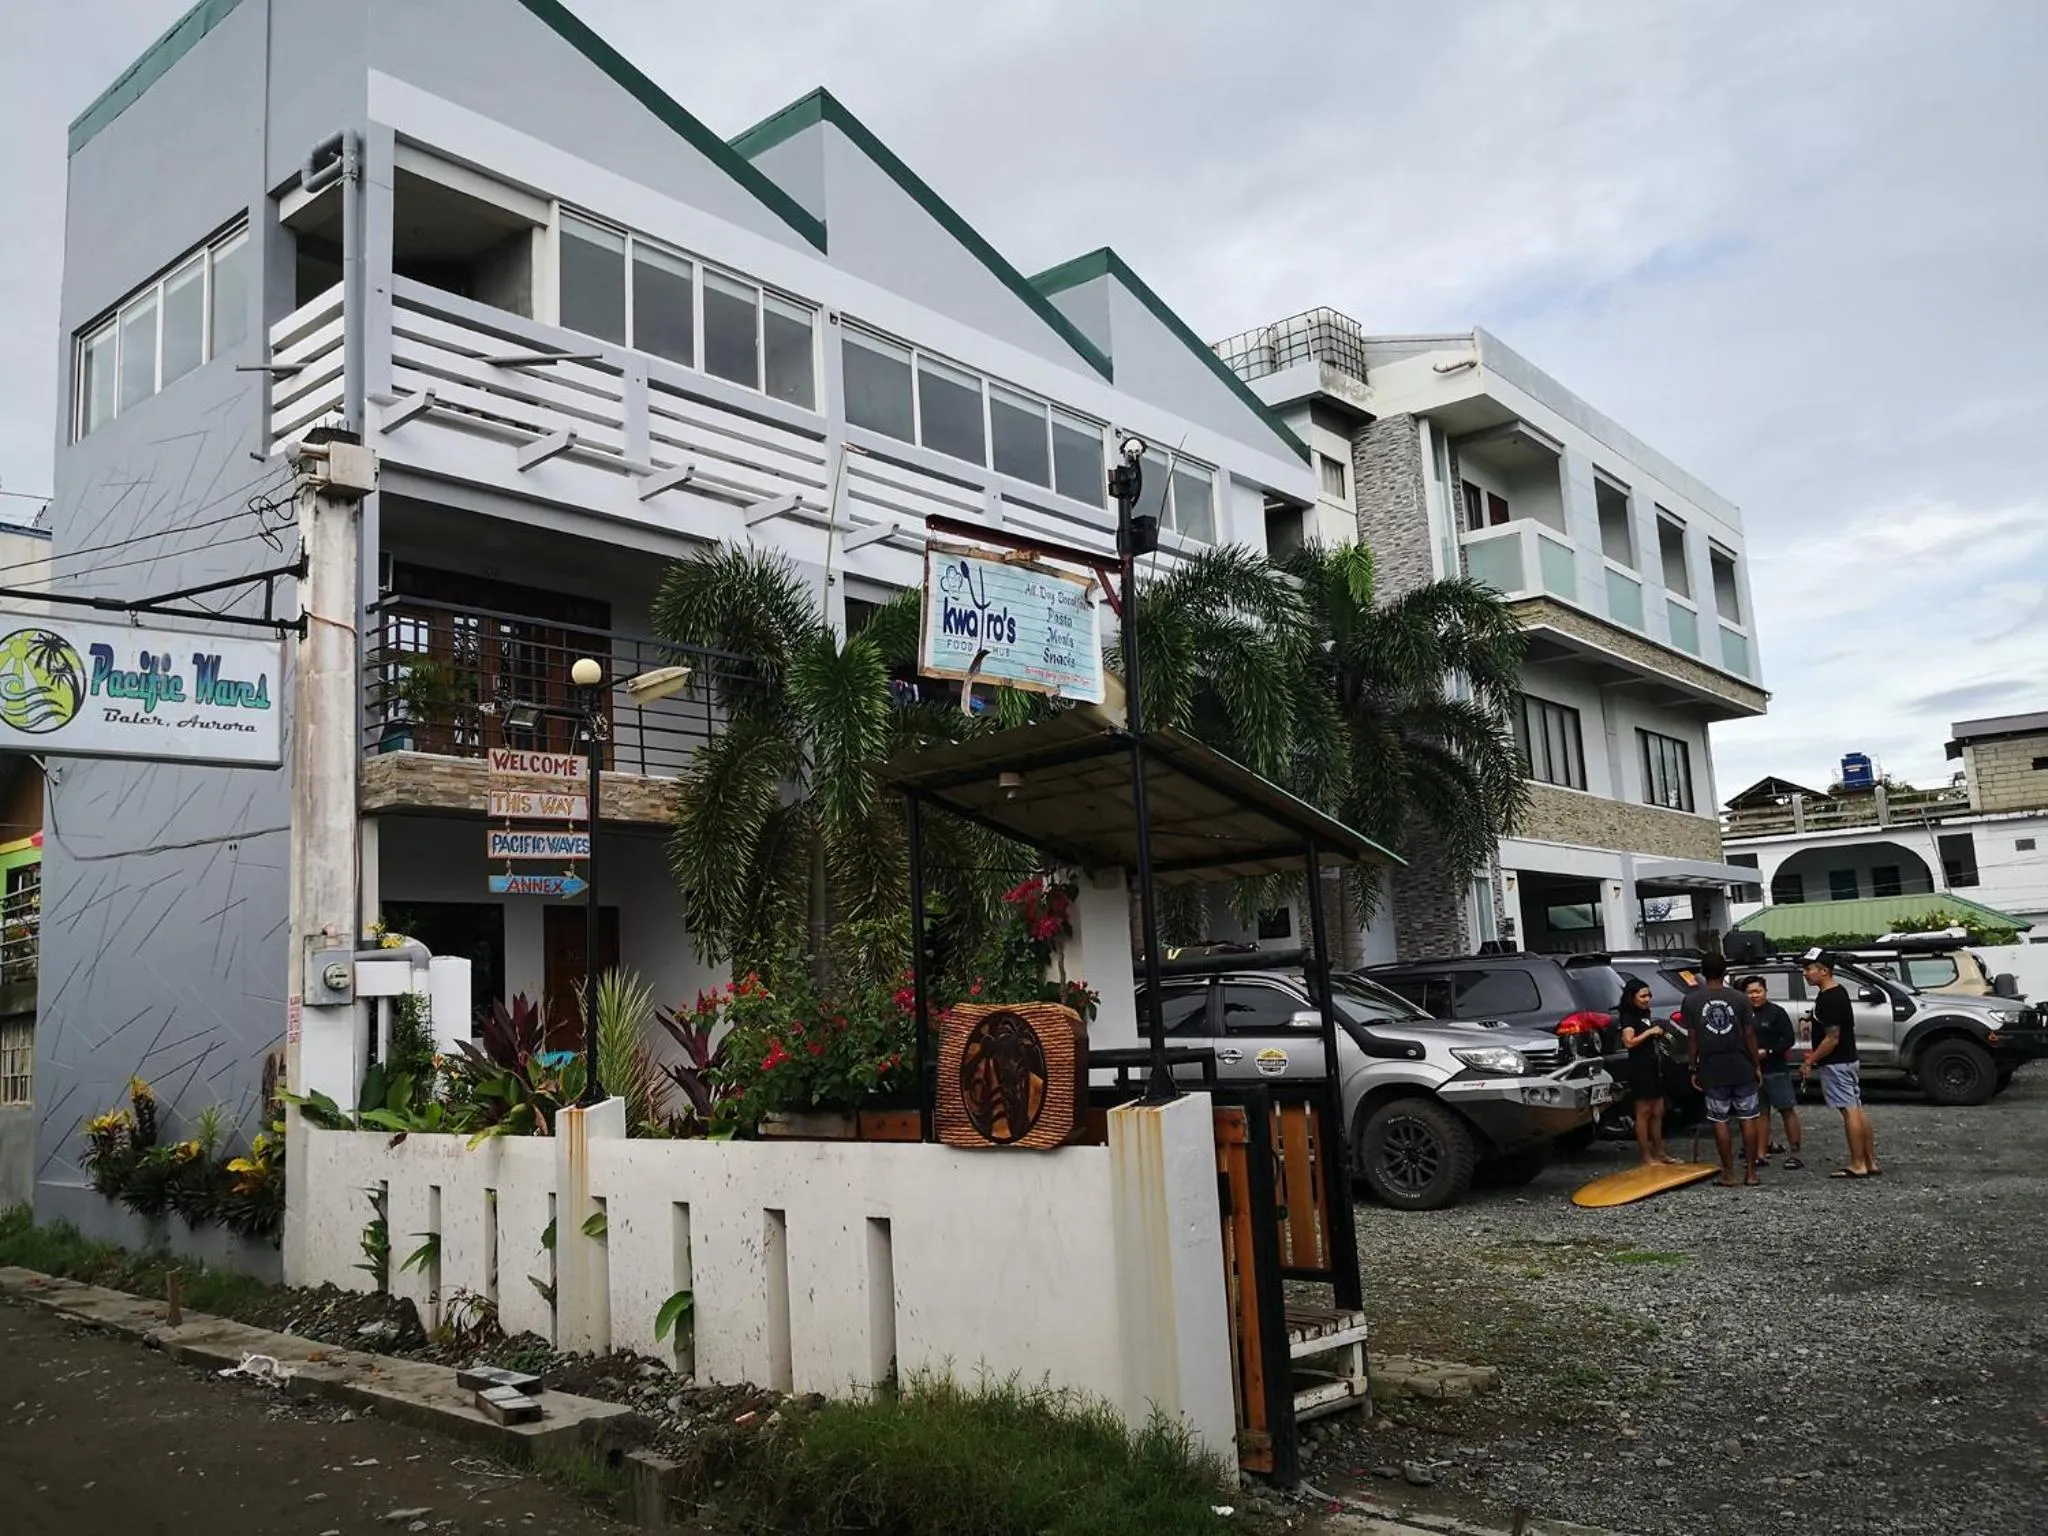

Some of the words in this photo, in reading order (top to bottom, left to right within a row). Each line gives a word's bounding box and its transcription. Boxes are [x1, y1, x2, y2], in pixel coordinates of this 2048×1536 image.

[1046, 607, 1073, 628] Pasta
[946, 639, 973, 652] FOOD
[89, 643, 187, 713] Pacific
[192, 653, 271, 710] Waves
[103, 707, 170, 728] Baler,
[176, 715, 258, 733] Aurora
[492, 750, 578, 777] WELCOME
[492, 793, 532, 813] THIS
[538, 796, 576, 816] WAY
[492, 833, 545, 854] PACIFIC
[546, 836, 591, 855] WAVES
[507, 877, 564, 893] ANNEX
